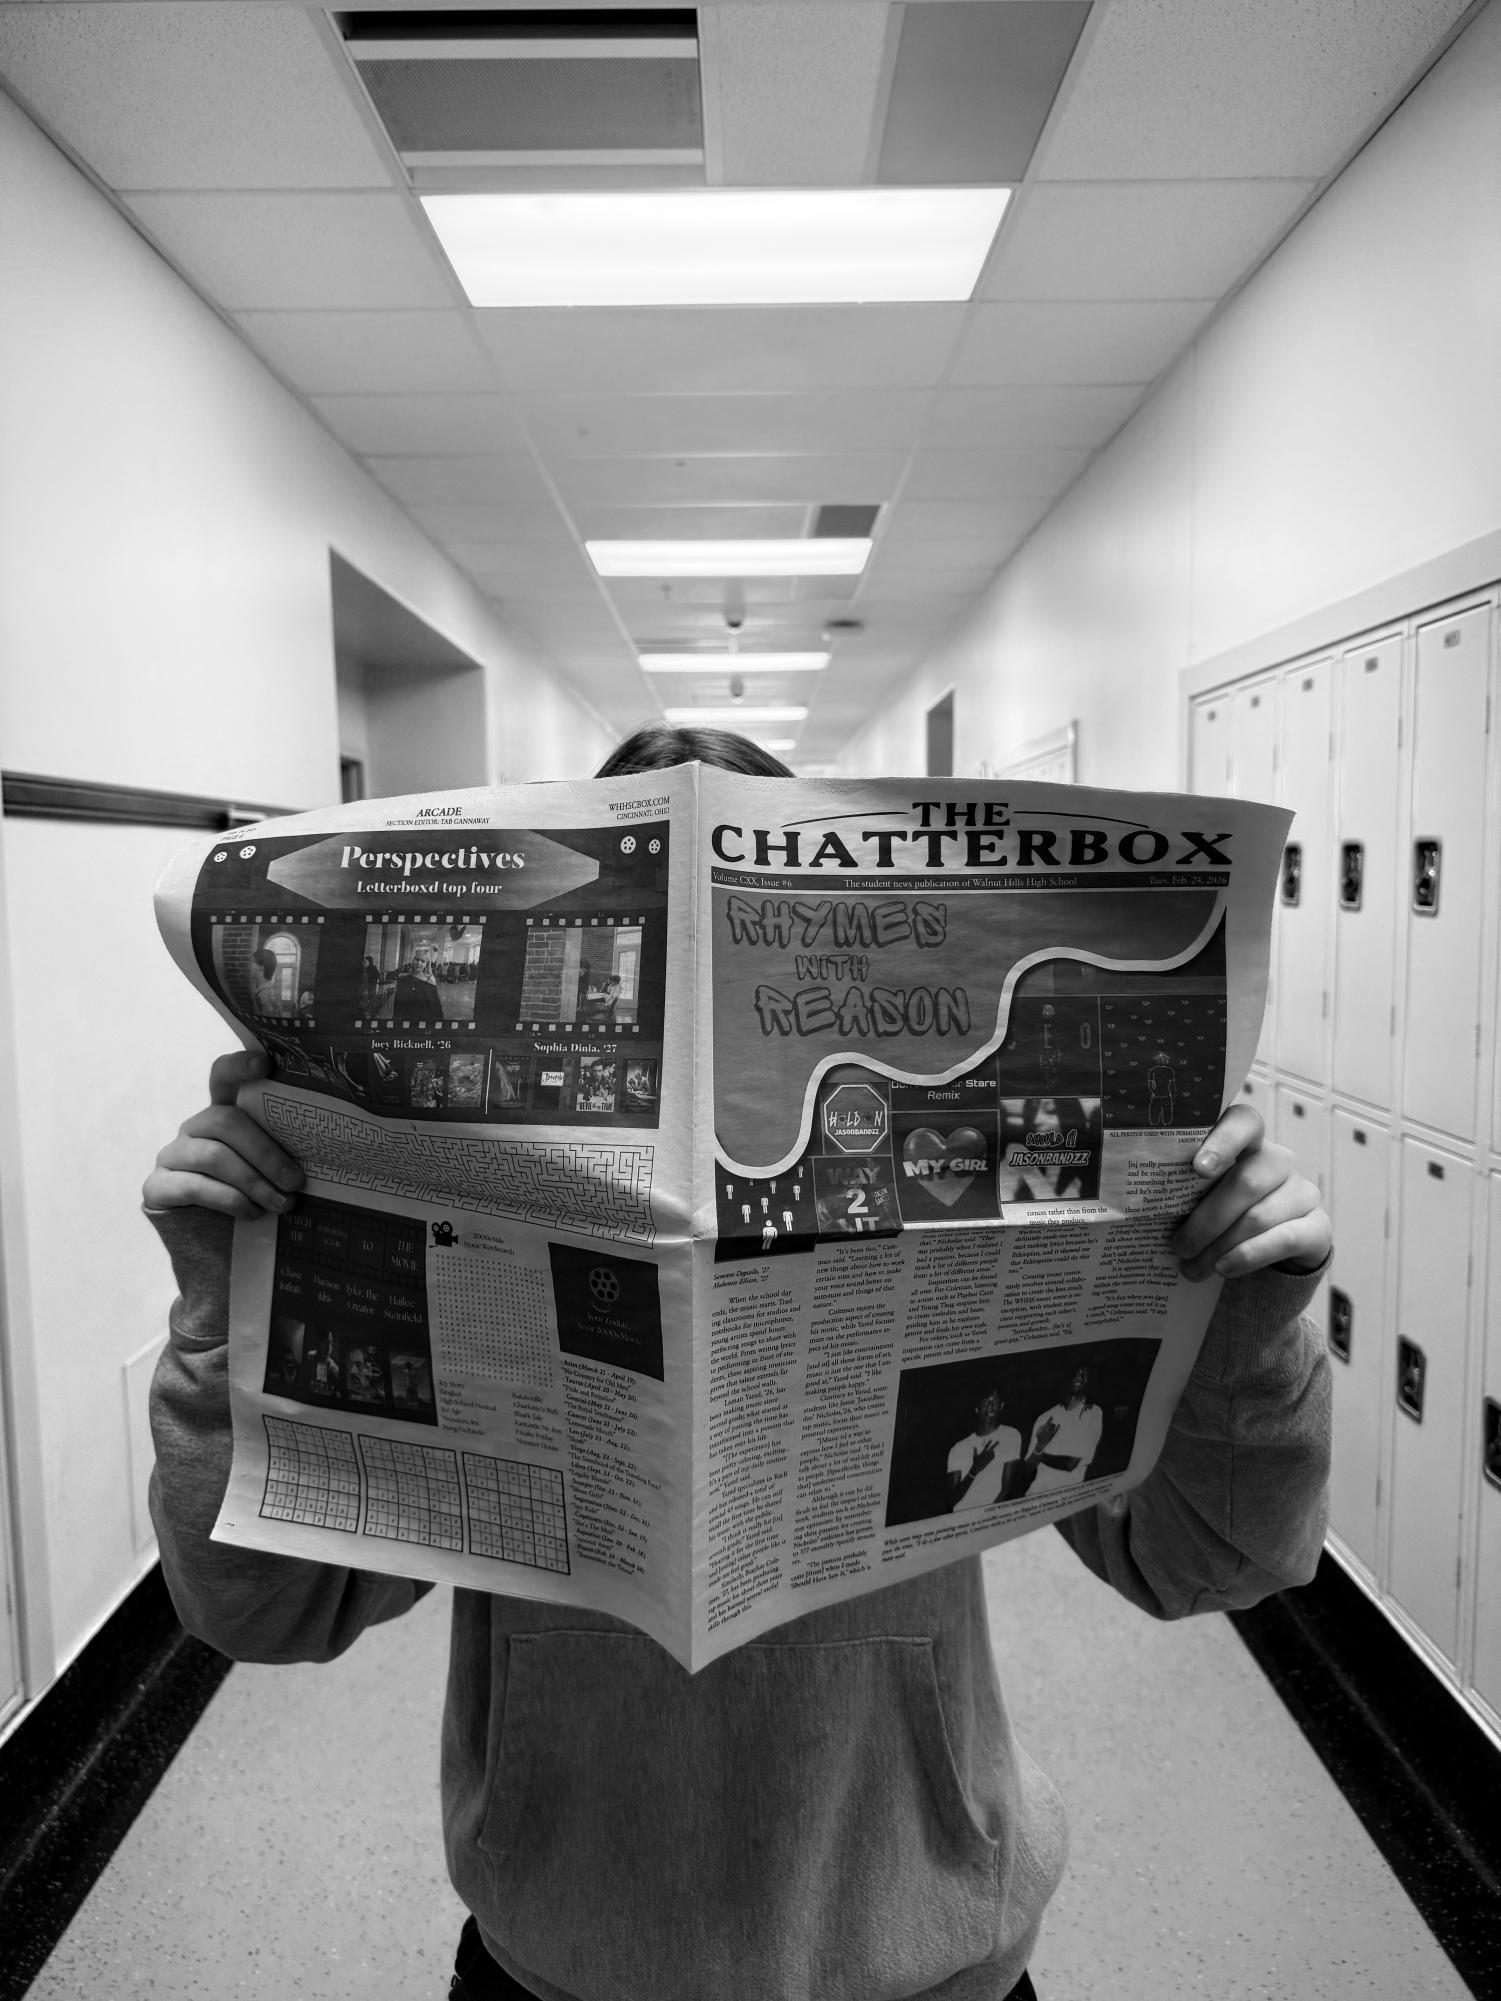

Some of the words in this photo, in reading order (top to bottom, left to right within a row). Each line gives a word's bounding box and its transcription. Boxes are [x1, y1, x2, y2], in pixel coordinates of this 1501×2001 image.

[416, 807, 463, 818] ARCADE
[912, 802, 1010, 827] THE
[414, 819, 440, 827] EDITOR:
[453, 817, 490, 825] GANNAWAY
[711, 824, 1232, 868] CHATTERBOX
[340, 845, 525, 877] Perspectives
[712, 871, 738, 883] Volume
[740, 877, 759, 887] CXX,
[761, 878, 780, 887] Issue
[844, 879, 860, 888] The
[861, 879, 890, 888] student
[915, 878, 959, 891] publication
[961, 878, 971, 888] of
[972, 878, 1002, 888] Walnut
[1004, 877, 1024, 887] Hills
[1026, 876, 1047, 889] High
[1049, 876, 1078, 886] School
[357, 880, 439, 894] Letterboxd
[442, 882, 466, 898] top
[471, 881, 503, 894] four
[726, 895, 947, 949] RHYMES
[795, 954, 870, 982] WITH
[754, 984, 971, 1038] REASON
[370, 1039, 390, 1051] Joey
[534, 1042, 568, 1054] Sophia
[965, 1080, 997, 1088] Stare
[927, 1091, 960, 1100] Remix
[1009, 1150, 1091, 1167] JASONBANDZZ
[1139, 1161, 1156, 1169] really
[827, 1167, 880, 1184] WAY
[902, 1159, 946, 1178] MY
[950, 1158, 988, 1172] GIRL
[846, 1188, 869, 1214] 2
[1048, 1208, 1066, 1216] rather
[1067, 1207, 1080, 1215] than
[1097, 1206, 1108, 1214] the
[830, 1265, 849, 1273] things
[729, 1296, 747, 1304] When
[760, 1290, 780, 1299] school
[781, 1289, 792, 1298] day
[814, 1285, 828, 1293] your
[711, 1308, 728, 1317] ends,
[728, 1306, 739, 1314] the
[739, 1304, 758, 1312] music
[722, 1314, 755, 1324] classrooms
[766, 1308, 788, 1316] studios
[789, 1304, 801, 1312] and
[828, 1307, 854, 1315] Coleman
[856, 1304, 875, 1312] enjoys
[711, 1325, 741, 1337] notebooks
[753, 1316, 793, 1327] microphones,
[711, 1337, 729, 1347] young
[730, 1333, 748, 1341] artists
[749, 1328, 767, 1338] spend
[711, 1343, 739, 1357] perfecting
[741, 1340, 757, 1348] songs
[783, 1331, 797, 1339] with
[740, 1349, 756, 1357] From
[758, 1344, 779, 1353] writing
[780, 1341, 796, 1350] lyrics
[717, 1360, 750, 1374] performing
